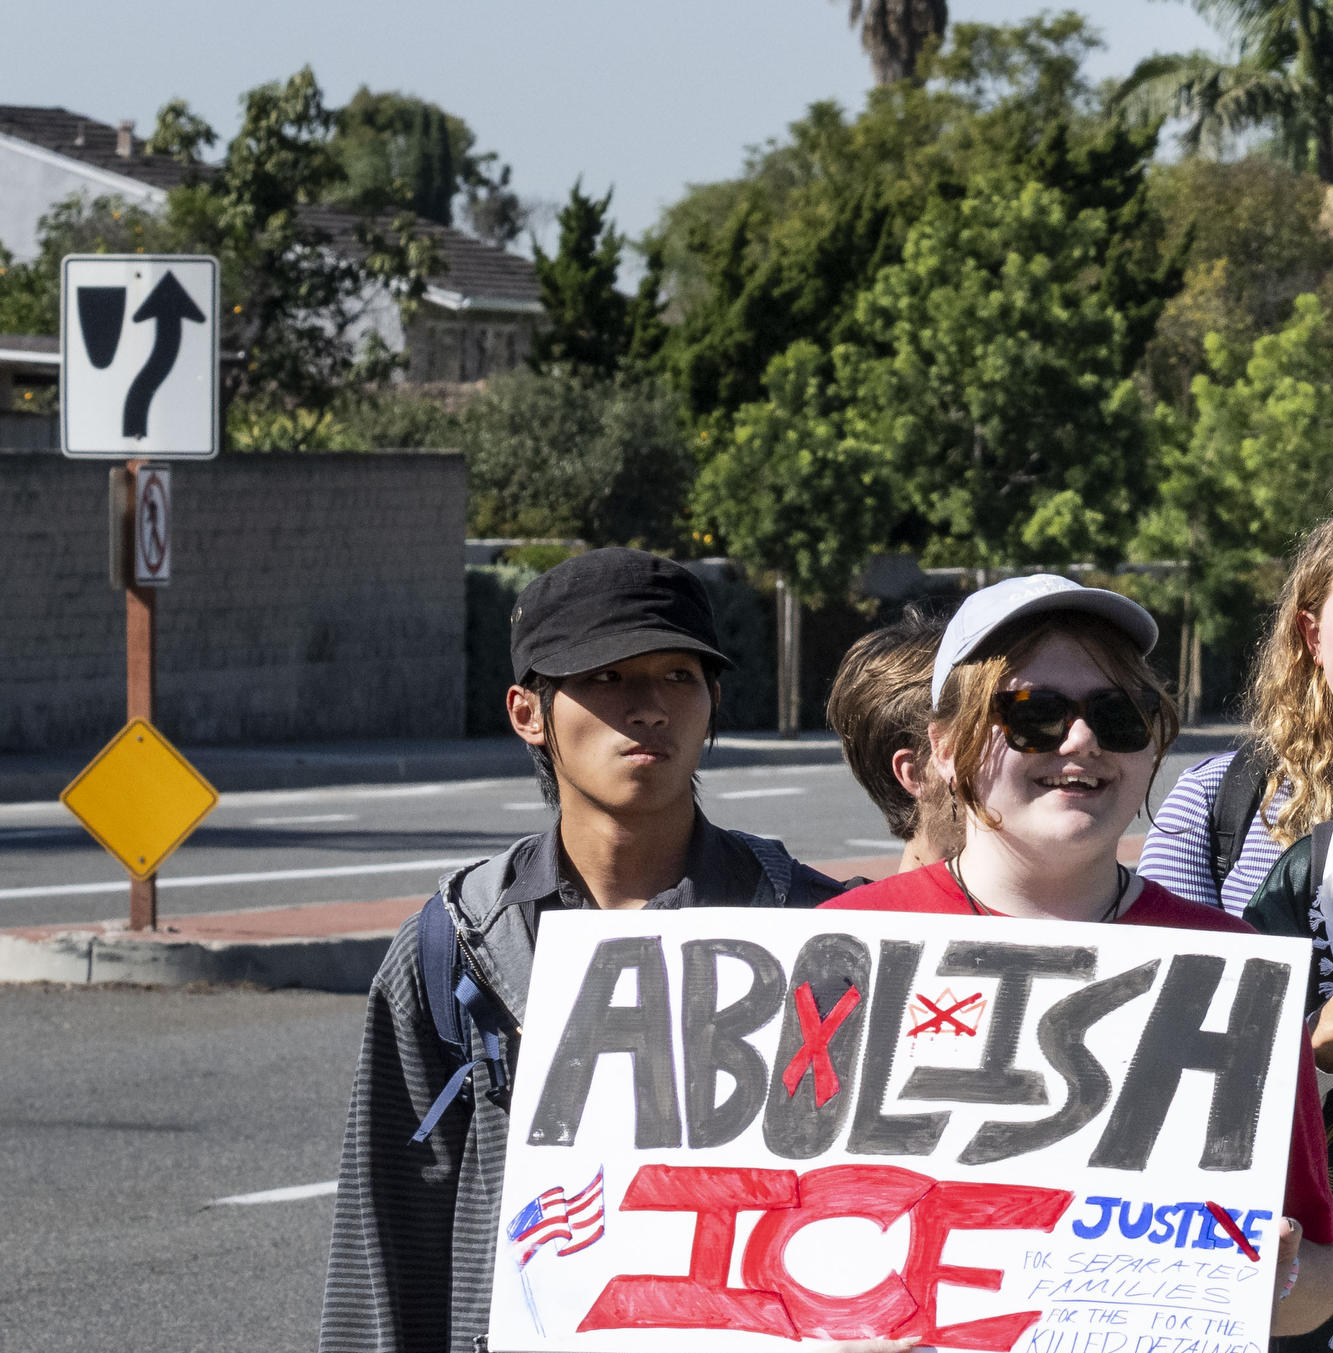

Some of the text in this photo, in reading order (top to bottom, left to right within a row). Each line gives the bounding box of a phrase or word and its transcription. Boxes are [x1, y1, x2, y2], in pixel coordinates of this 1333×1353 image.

[526, 931, 1292, 1172] ABOLISH
[1071, 1195, 1274, 1258] JUSTICE
[575, 1162, 1076, 1353] ICE
[1024, 1250, 1260, 1283] FOR SEPARATED
[1027, 1278, 1232, 1304] FAMILIES
[1046, 1308, 1129, 1325] FOR THE
[1151, 1312, 1246, 1337] FOR THE
